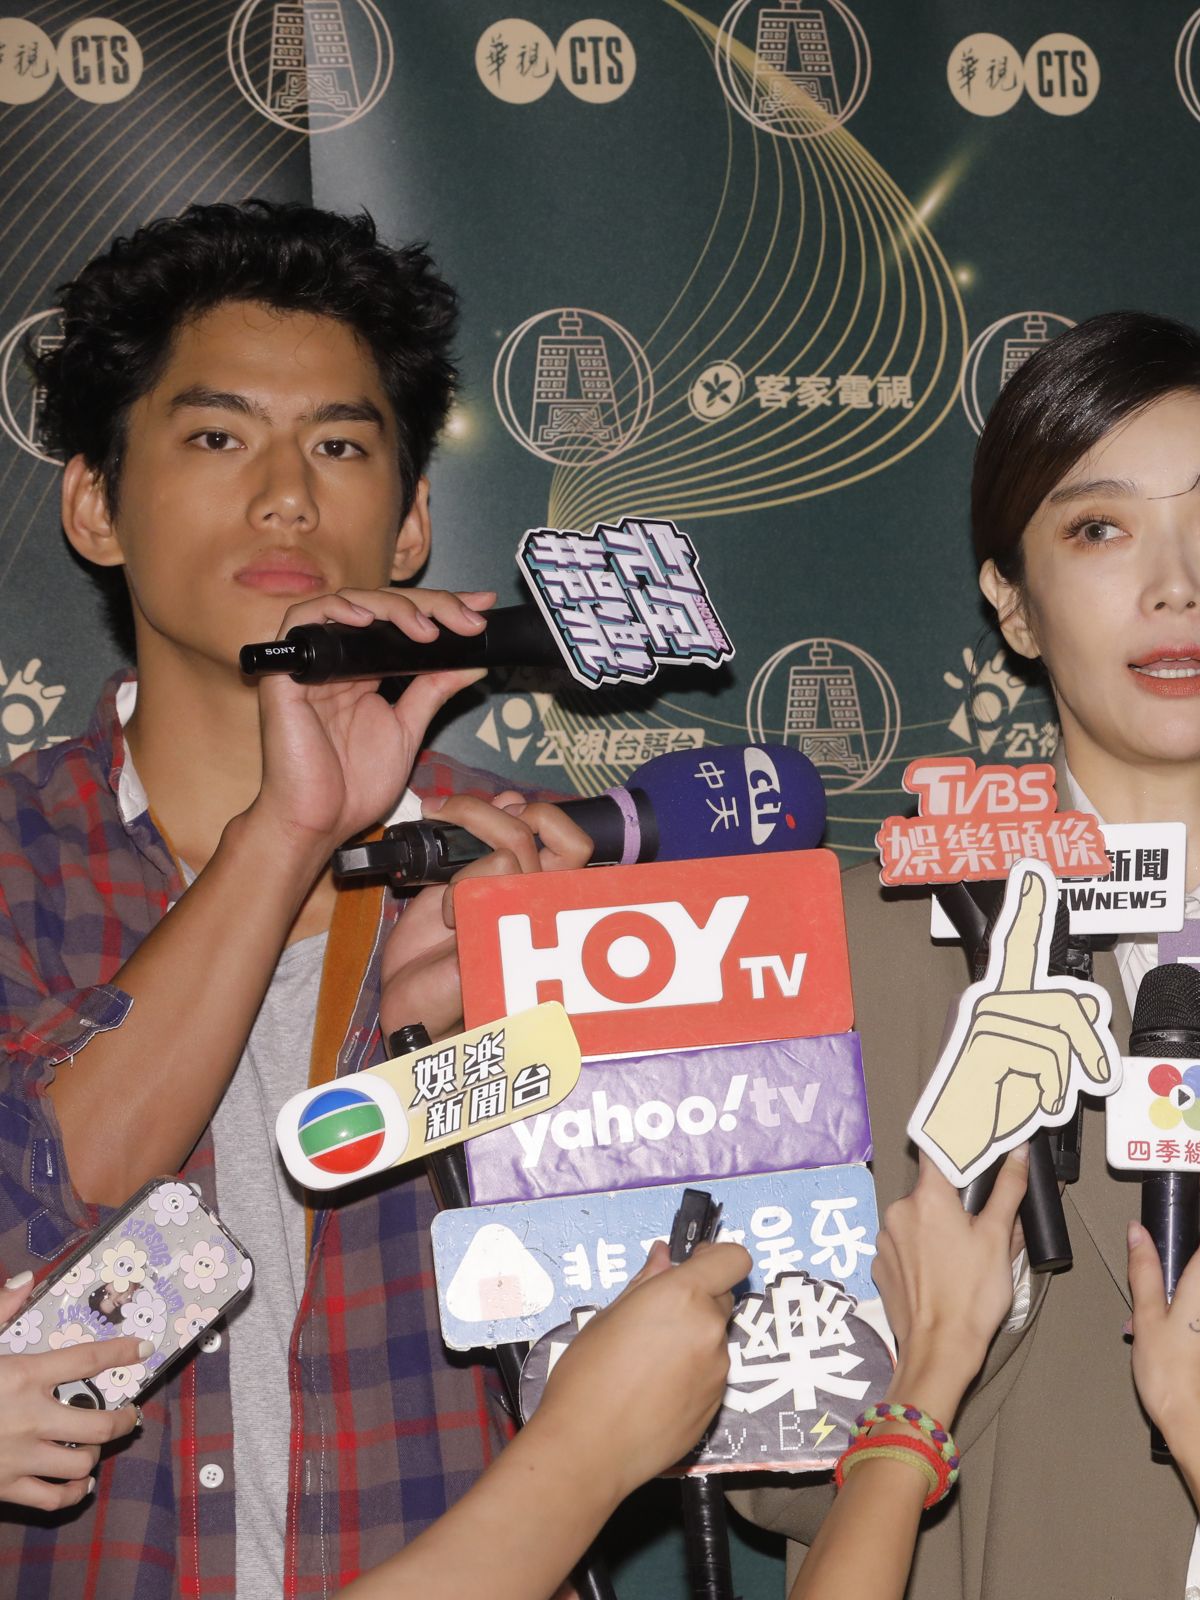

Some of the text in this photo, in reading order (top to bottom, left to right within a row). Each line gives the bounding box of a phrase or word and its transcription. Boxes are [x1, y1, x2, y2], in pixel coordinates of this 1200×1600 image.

[71, 35, 130, 85] CTS
[485, 33, 624, 88] 華視 CTS
[957, 48, 1088, 100] 華視 CTS
[754, 374, 915, 410] 客家電視
[691, 593, 730, 651] SHOWBIZ
[265, 646, 296, 656] SONY
[694, 761, 741, 833] 中天
[912, 765, 1049, 816] TVBS
[886, 816, 1103, 878] 娛樂頭條
[1061, 848, 1169, 883] 新聞
[1058, 887, 1167, 911] WNEWS
[498, 895, 807, 1016] HOY TV
[422, 1062, 553, 1144] 新聞台
